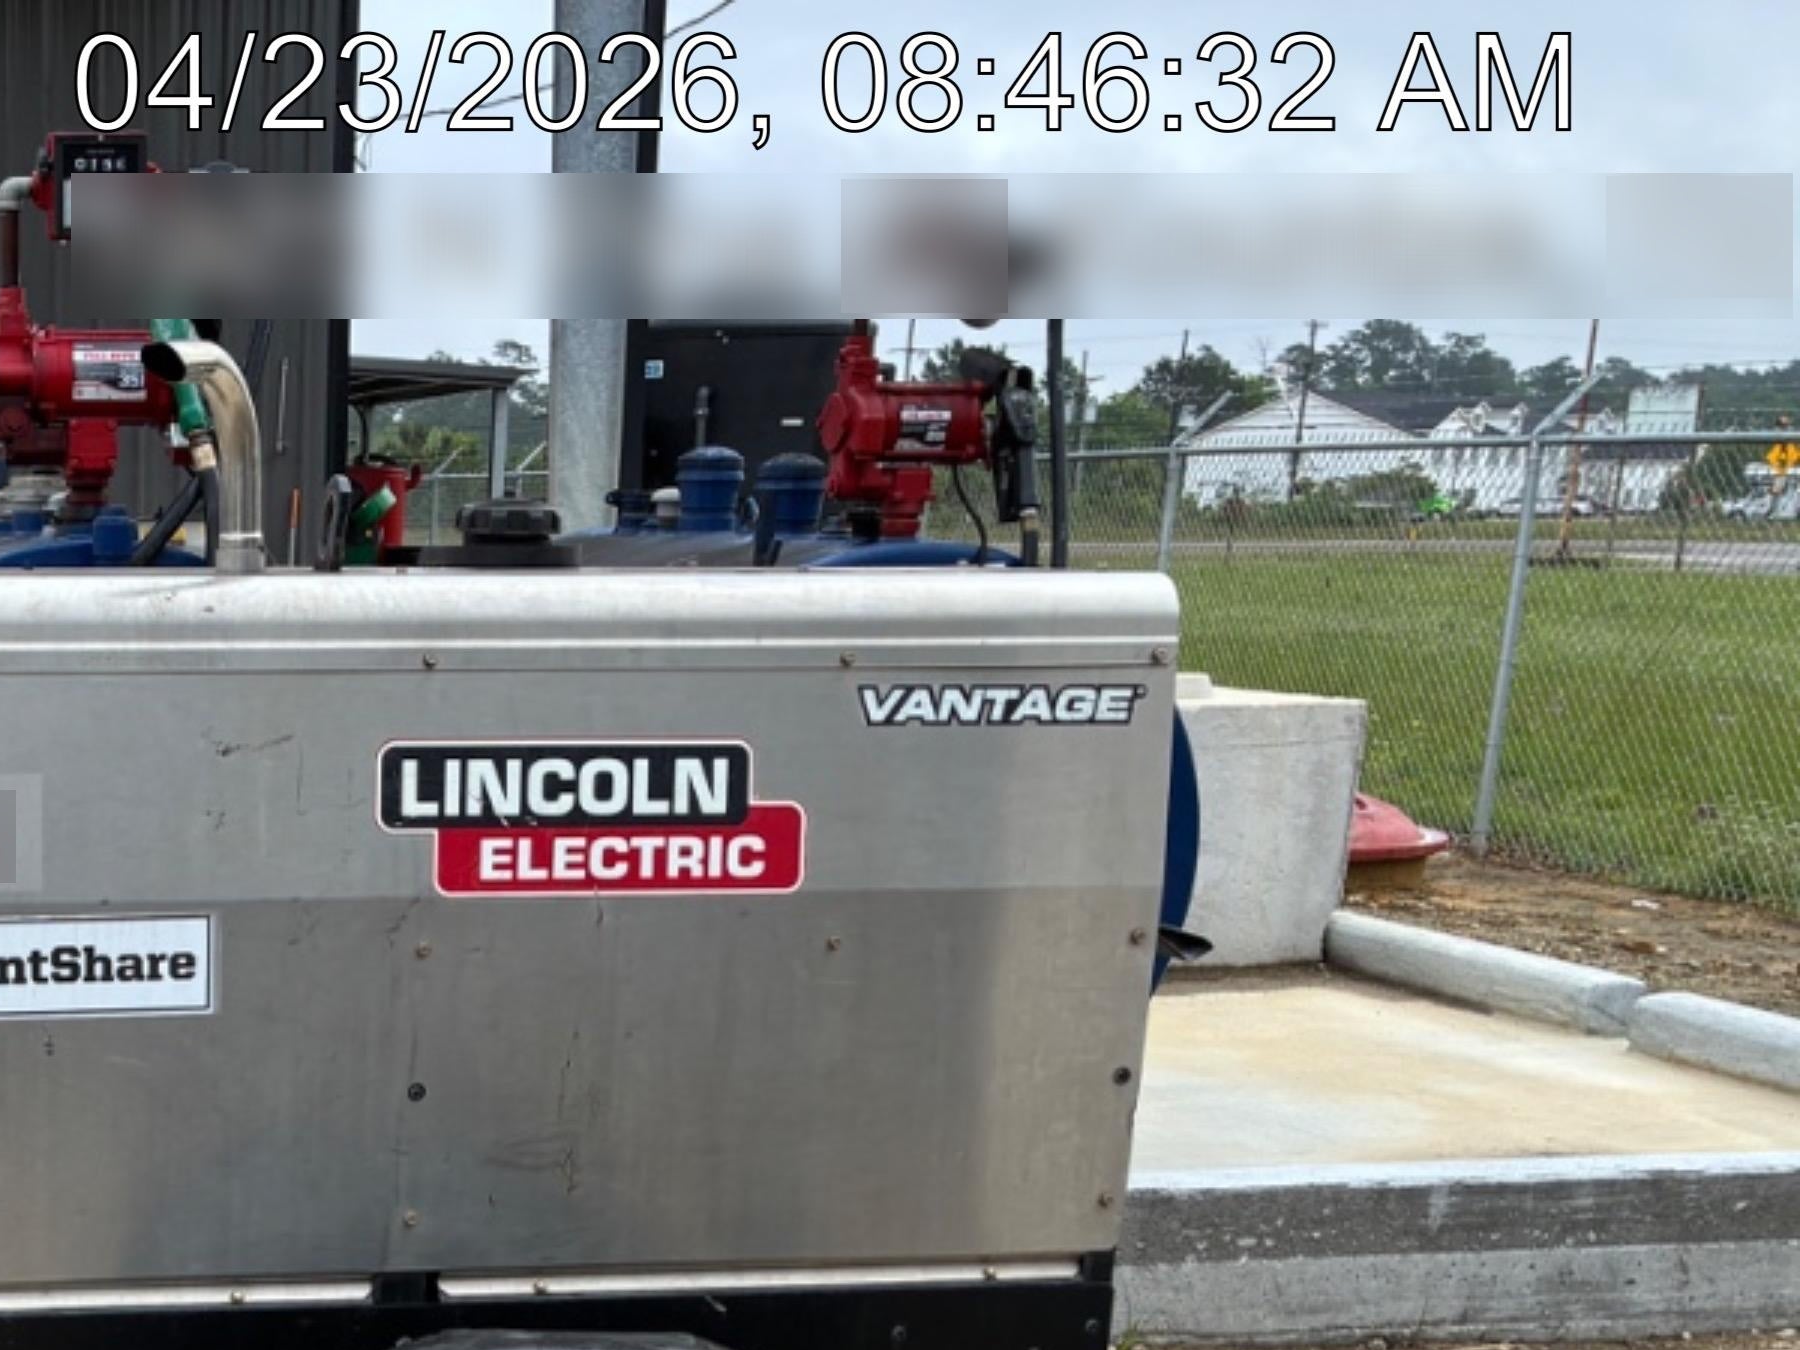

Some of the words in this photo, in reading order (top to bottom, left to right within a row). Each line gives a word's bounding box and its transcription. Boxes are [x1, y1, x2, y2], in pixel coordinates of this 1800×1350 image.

[859, 685, 1135, 725] VANTAGE
[401, 757, 729, 818] LINCOLN
[479, 835, 766, 881] ELECTRIC
